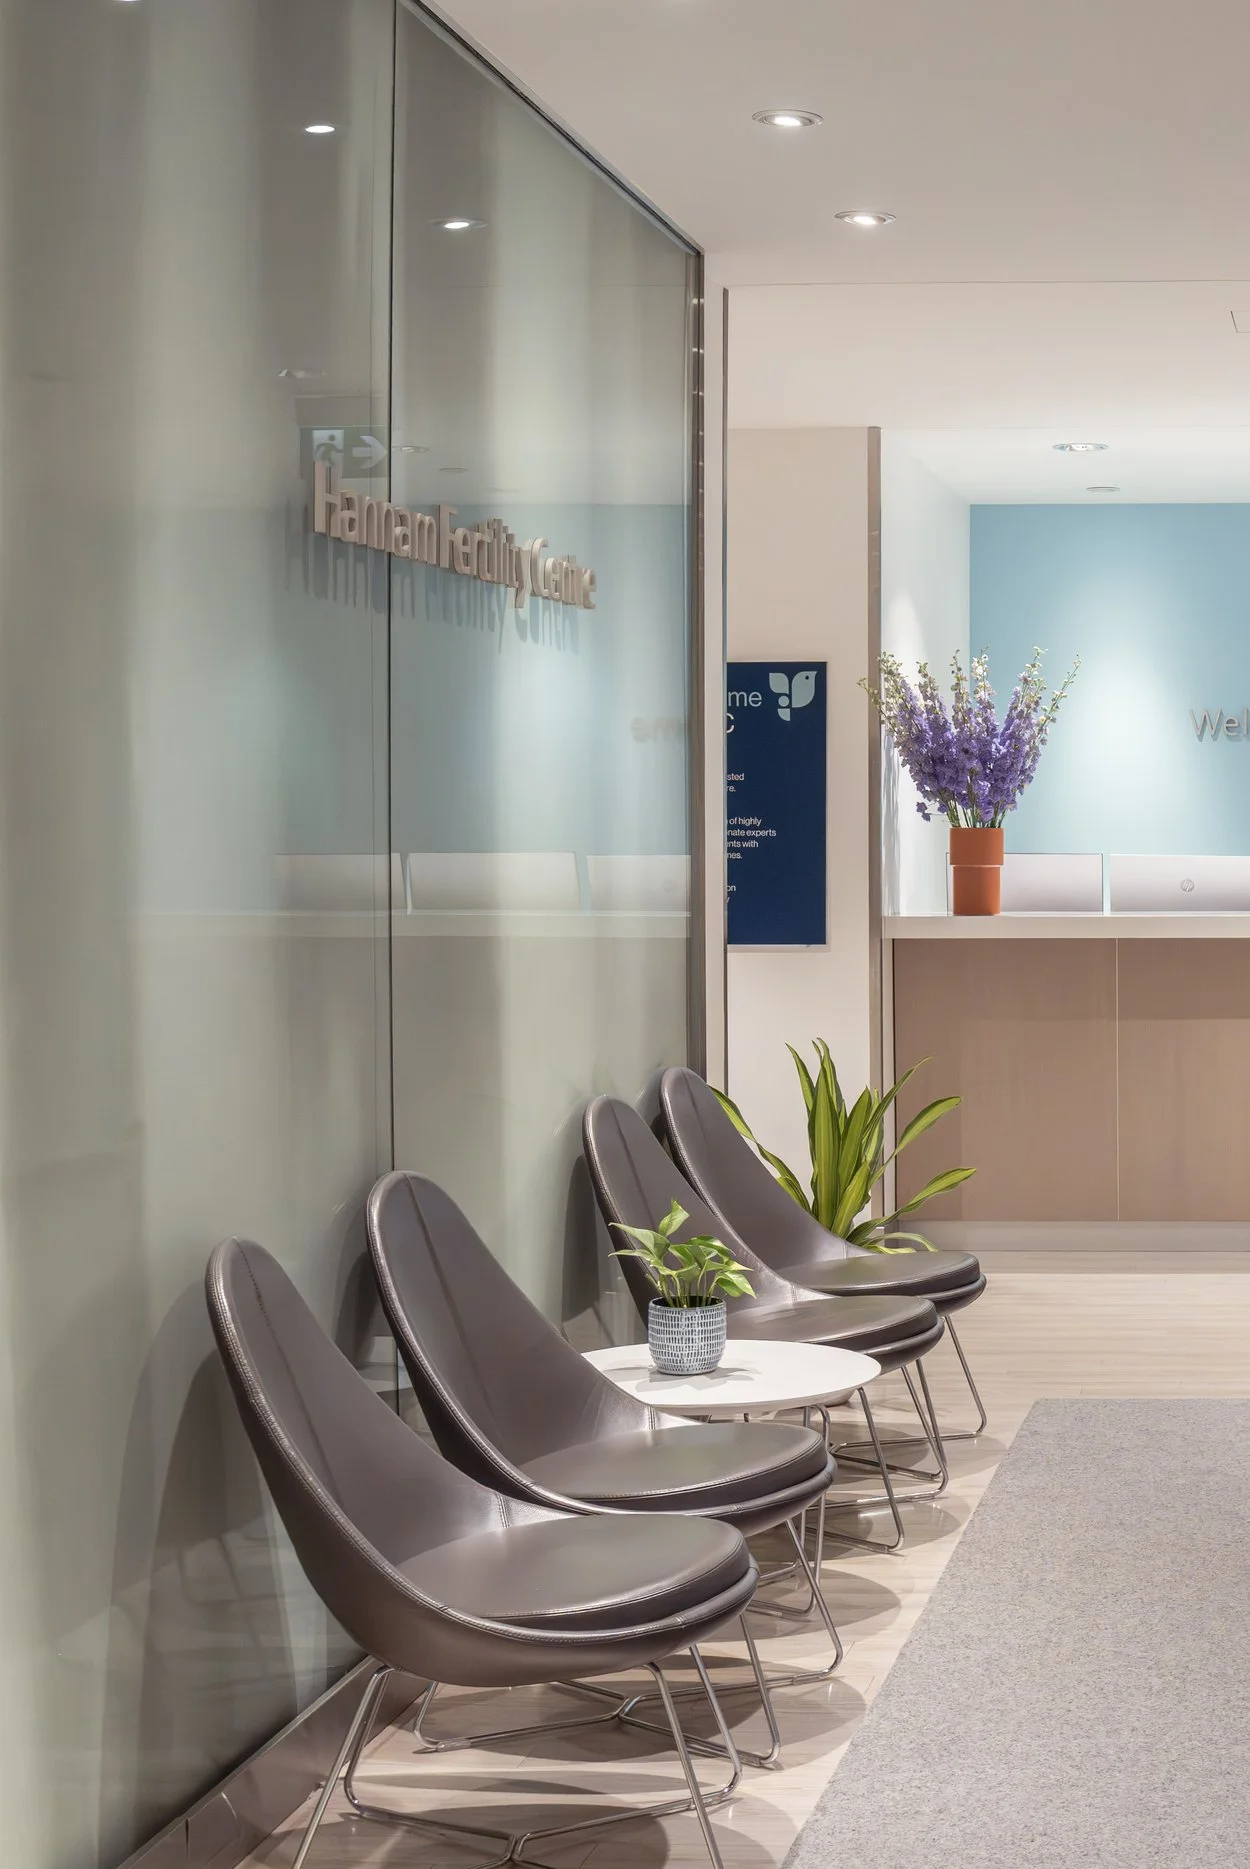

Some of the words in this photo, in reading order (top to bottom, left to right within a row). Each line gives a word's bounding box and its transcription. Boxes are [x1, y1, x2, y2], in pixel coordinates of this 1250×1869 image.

[313, 461, 437, 565] Hannam
[438, 504, 530, 608] Fertility
[531, 538, 596, 609] Centre
[729, 817, 738, 825] of
[739, 817, 762, 827] highly
[746, 828, 777, 838] experts
[742, 840, 759, 848] with
